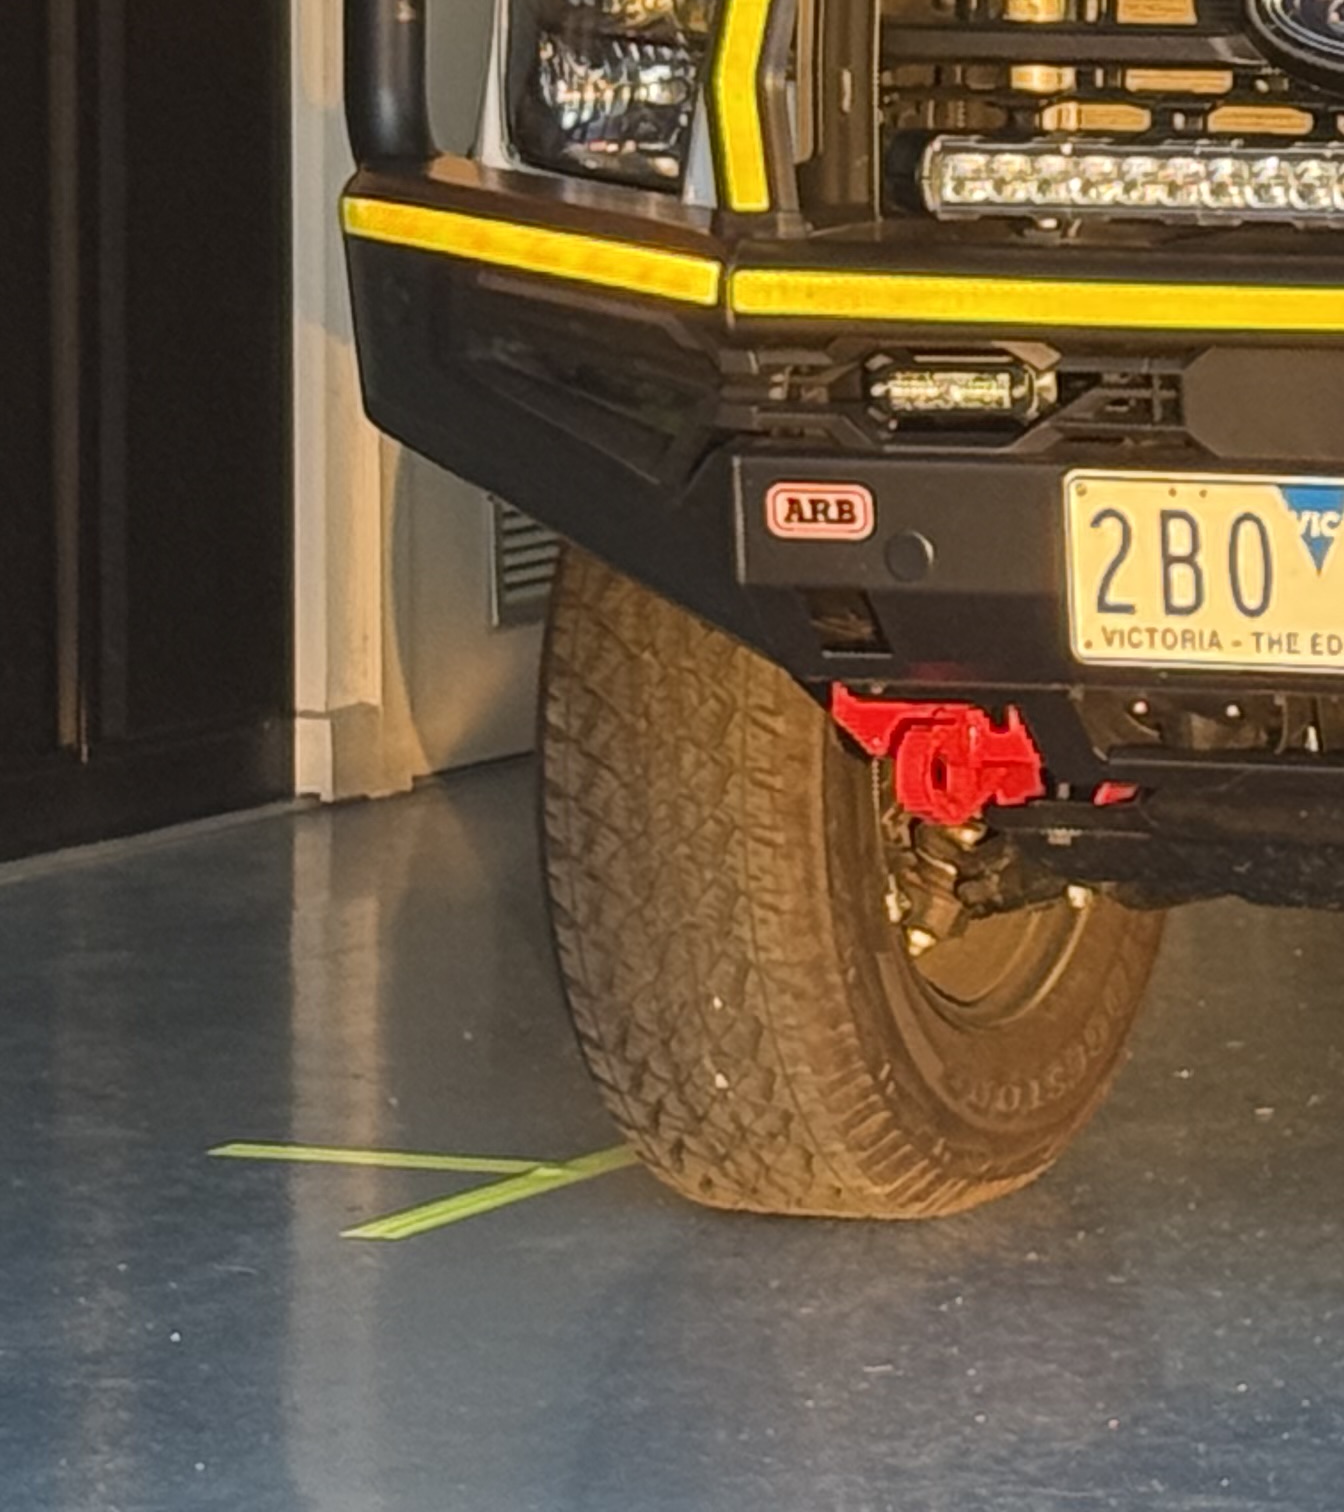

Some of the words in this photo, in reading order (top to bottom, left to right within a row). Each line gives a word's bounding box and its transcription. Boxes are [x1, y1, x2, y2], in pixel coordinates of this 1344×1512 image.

[784, 496, 858, 525] ARB
[1292, 508, 1343, 539] VIC
[1100, 625, 1223, 651] VICTORIA
[1250, 631, 1302, 655] THE
